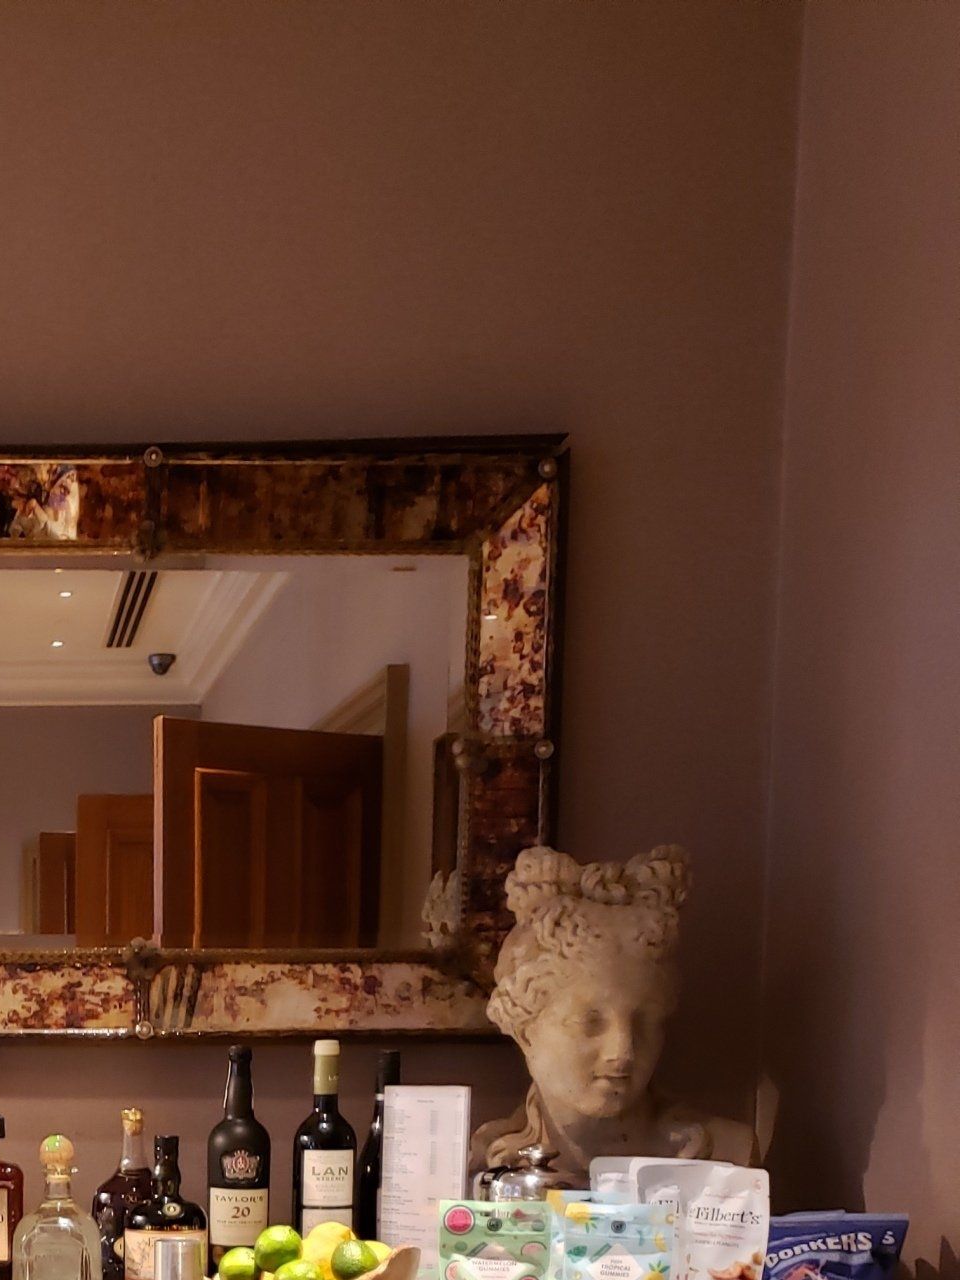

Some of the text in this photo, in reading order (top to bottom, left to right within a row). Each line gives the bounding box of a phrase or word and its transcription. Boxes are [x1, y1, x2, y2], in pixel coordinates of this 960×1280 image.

[311, 1166, 349, 1176] LAN
[215, 1194, 264, 1204] TAYLOR'S
[231, 1206, 251, 1219] 20
[695, 1206, 761, 1225] Filbert's
[601, 1263, 631, 1271] TROPICAL
[600, 1270, 630, 1278] GUMMIES
